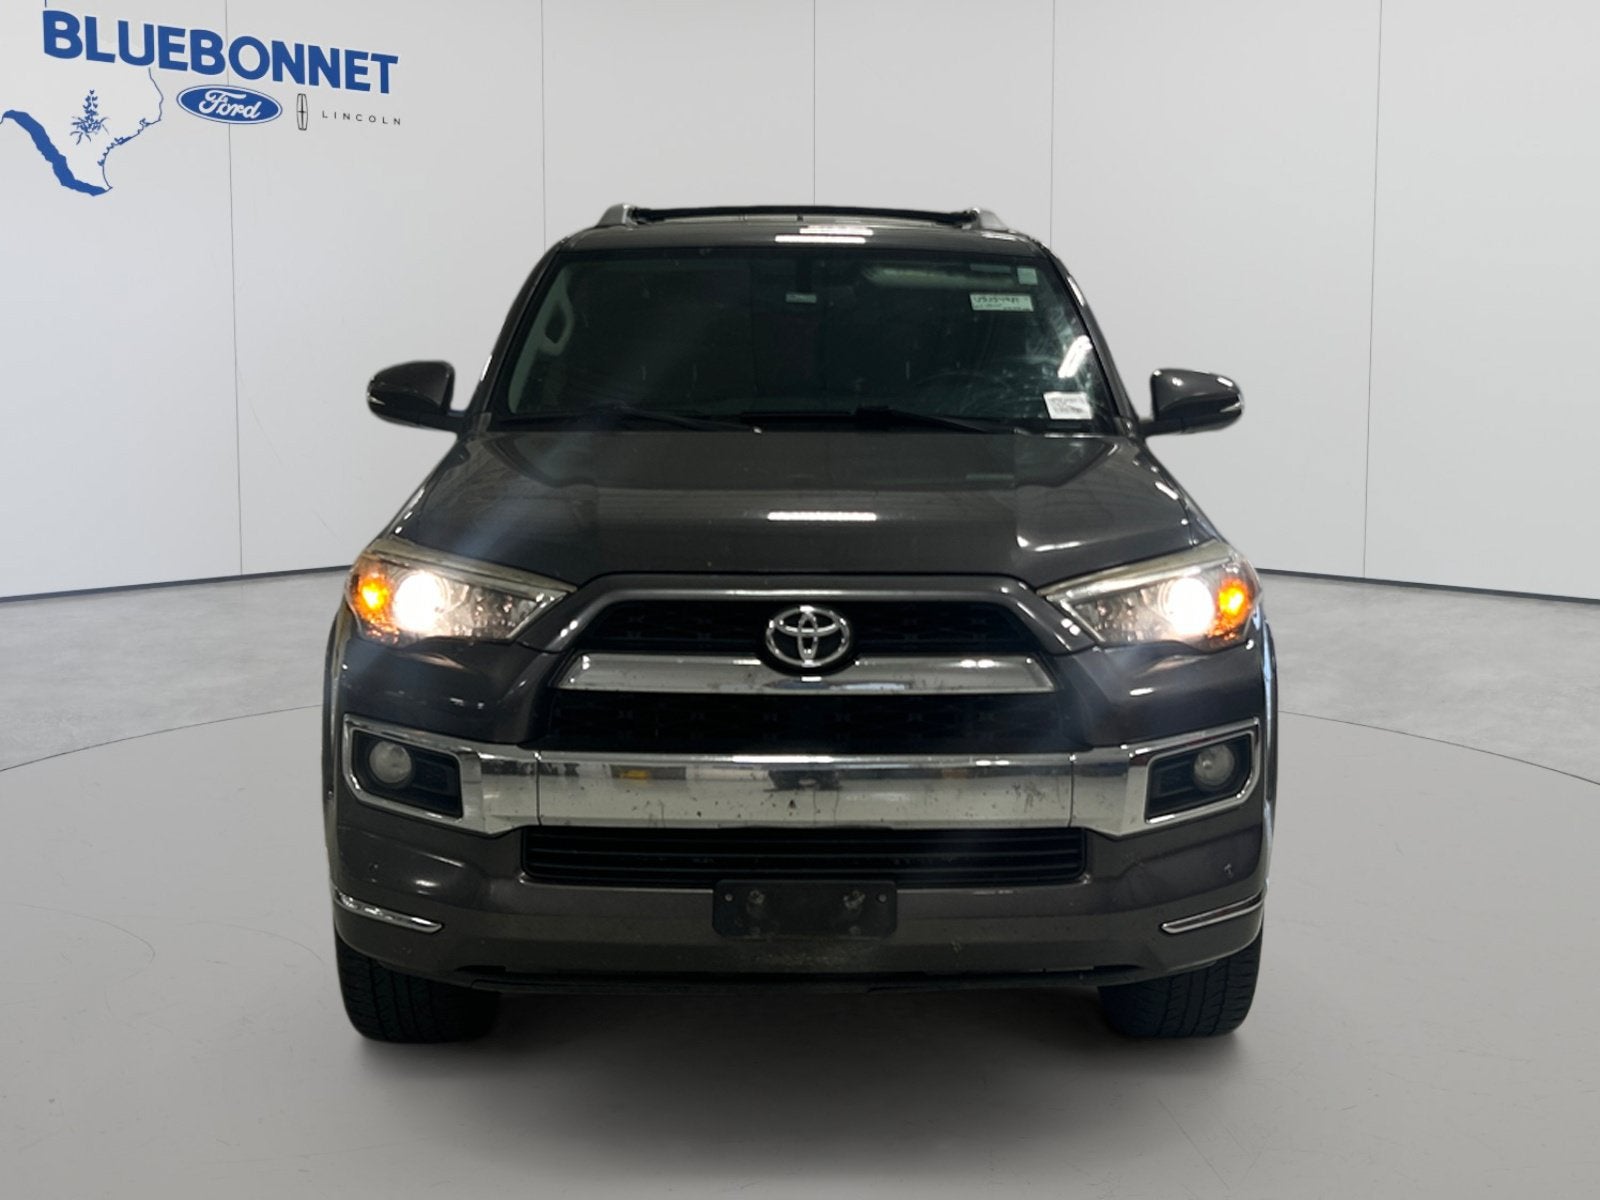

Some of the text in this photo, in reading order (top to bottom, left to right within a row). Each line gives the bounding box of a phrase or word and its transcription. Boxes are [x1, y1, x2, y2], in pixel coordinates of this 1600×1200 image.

[42, 9, 399, 95] BLUEBONNET
[198, 87, 262, 120] Ford
[321, 110, 402, 126] LINCOLN
